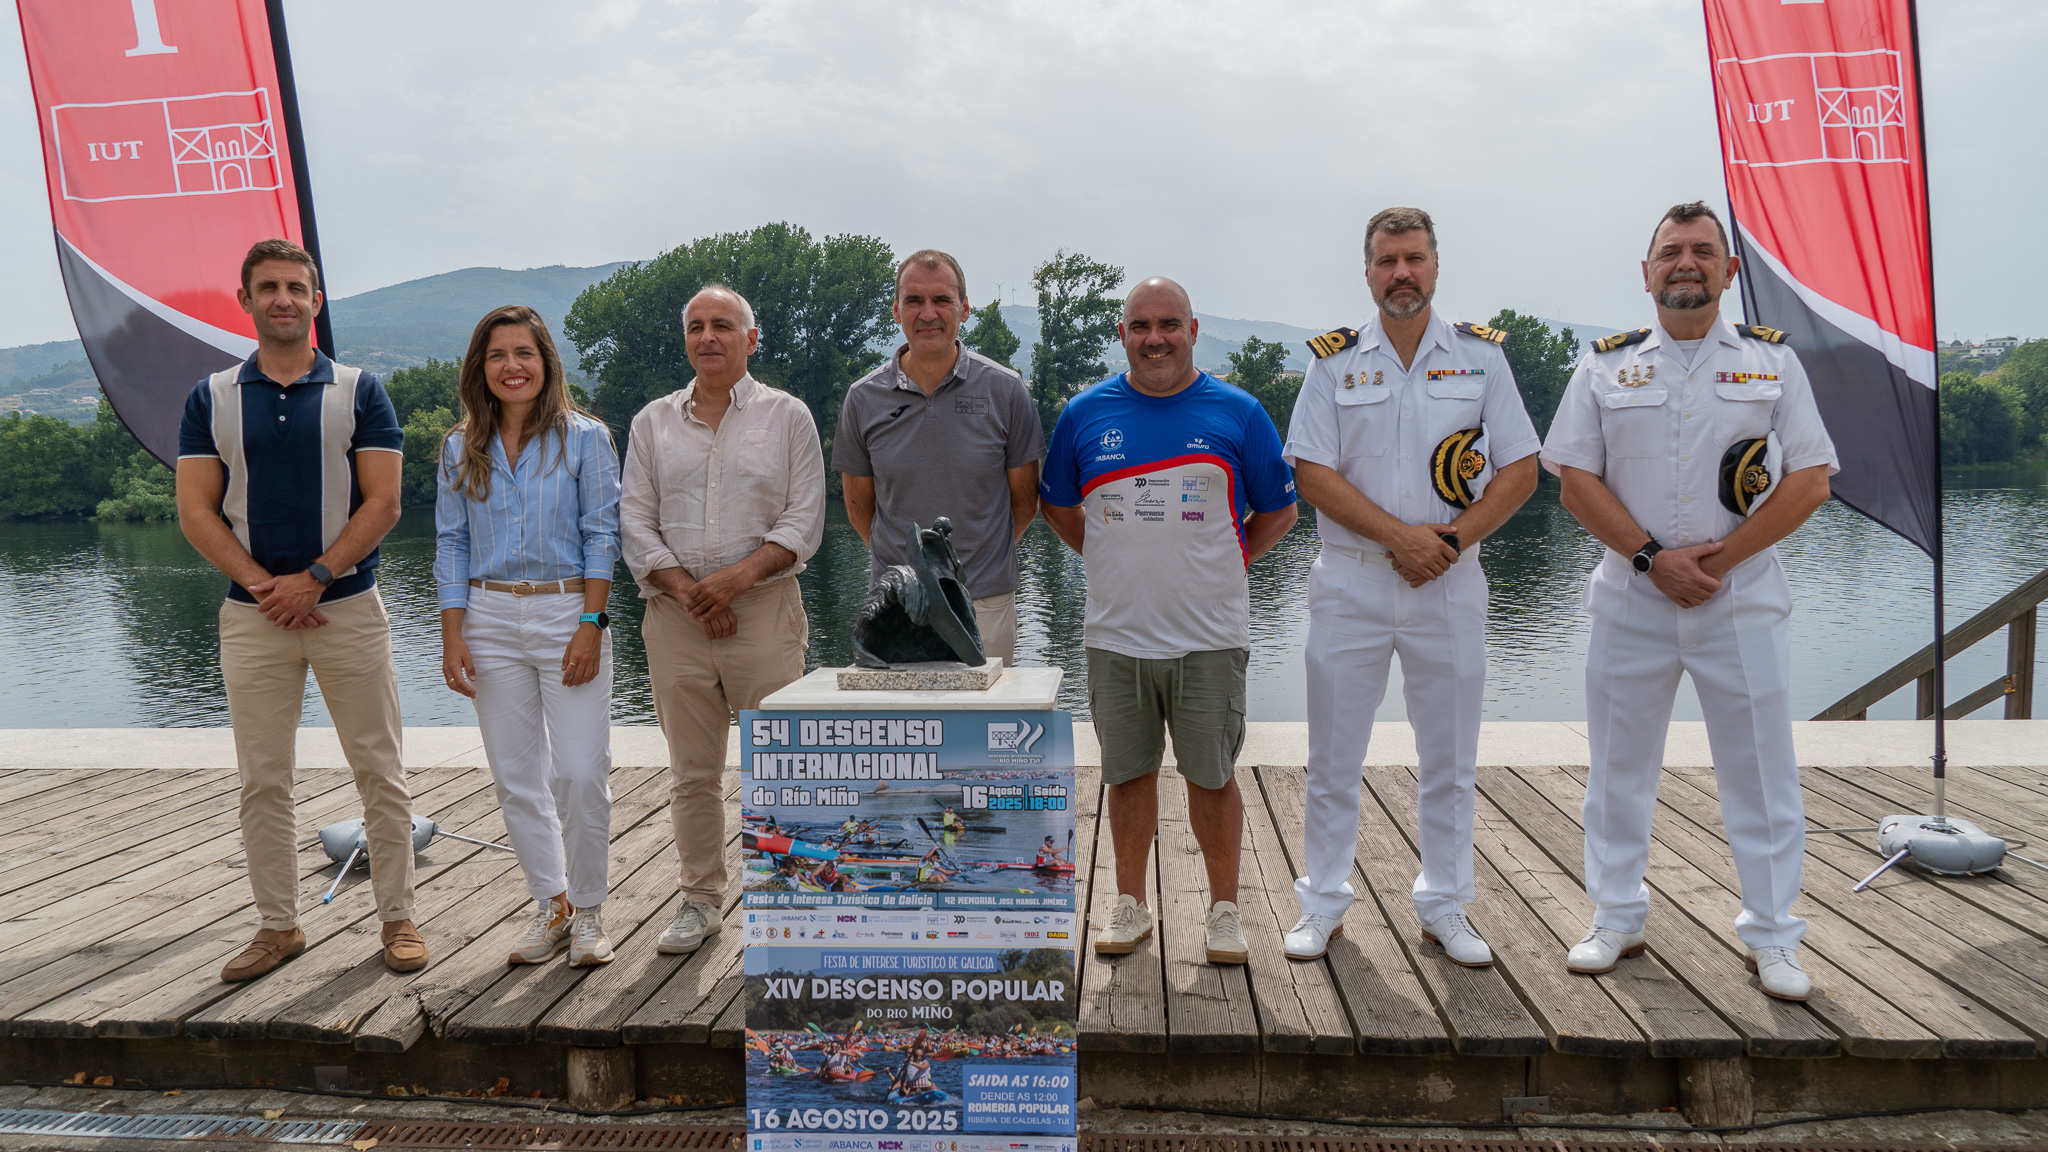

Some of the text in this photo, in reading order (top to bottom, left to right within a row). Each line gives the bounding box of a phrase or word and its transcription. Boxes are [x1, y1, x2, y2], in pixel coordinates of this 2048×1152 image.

[752, 719, 944, 746] 54 DESCENSO
[752, 752, 944, 780] INTERNACIONAL
[752, 786, 860, 806] do Río Miño
[962, 785, 1023, 809] 16 Agosto
[988, 797, 1023, 810] 2025
[1030, 797, 1067, 810] 18:00
[747, 894, 933, 905] Festa de Interese Turístico De Galicia
[945, 897, 956, 905] 42
[958, 897, 997, 905] MEMORIAL
[1042, 896, 1068, 906] JIMÉNEZ
[824, 956, 994, 969] FESTA DE INTERESE TURISTICO DE GALICIA
[764, 978, 1065, 1001] XIV DESCENSO POPULAR
[867, 1004, 953, 1019] DO RIO MIÑO
[968, 1074, 1069, 1088] SAIDA AS 16:00
[980, 1092, 1058, 1102] DENDE AS 12:00
[968, 1103, 1070, 1114] ROMERIA POPULAR
[751, 1108, 958, 1131] 16 AGOSTO 2025
[1013, 1117, 1051, 1125] CALDELAS
[829, 1141, 873, 1149] ABANCA
